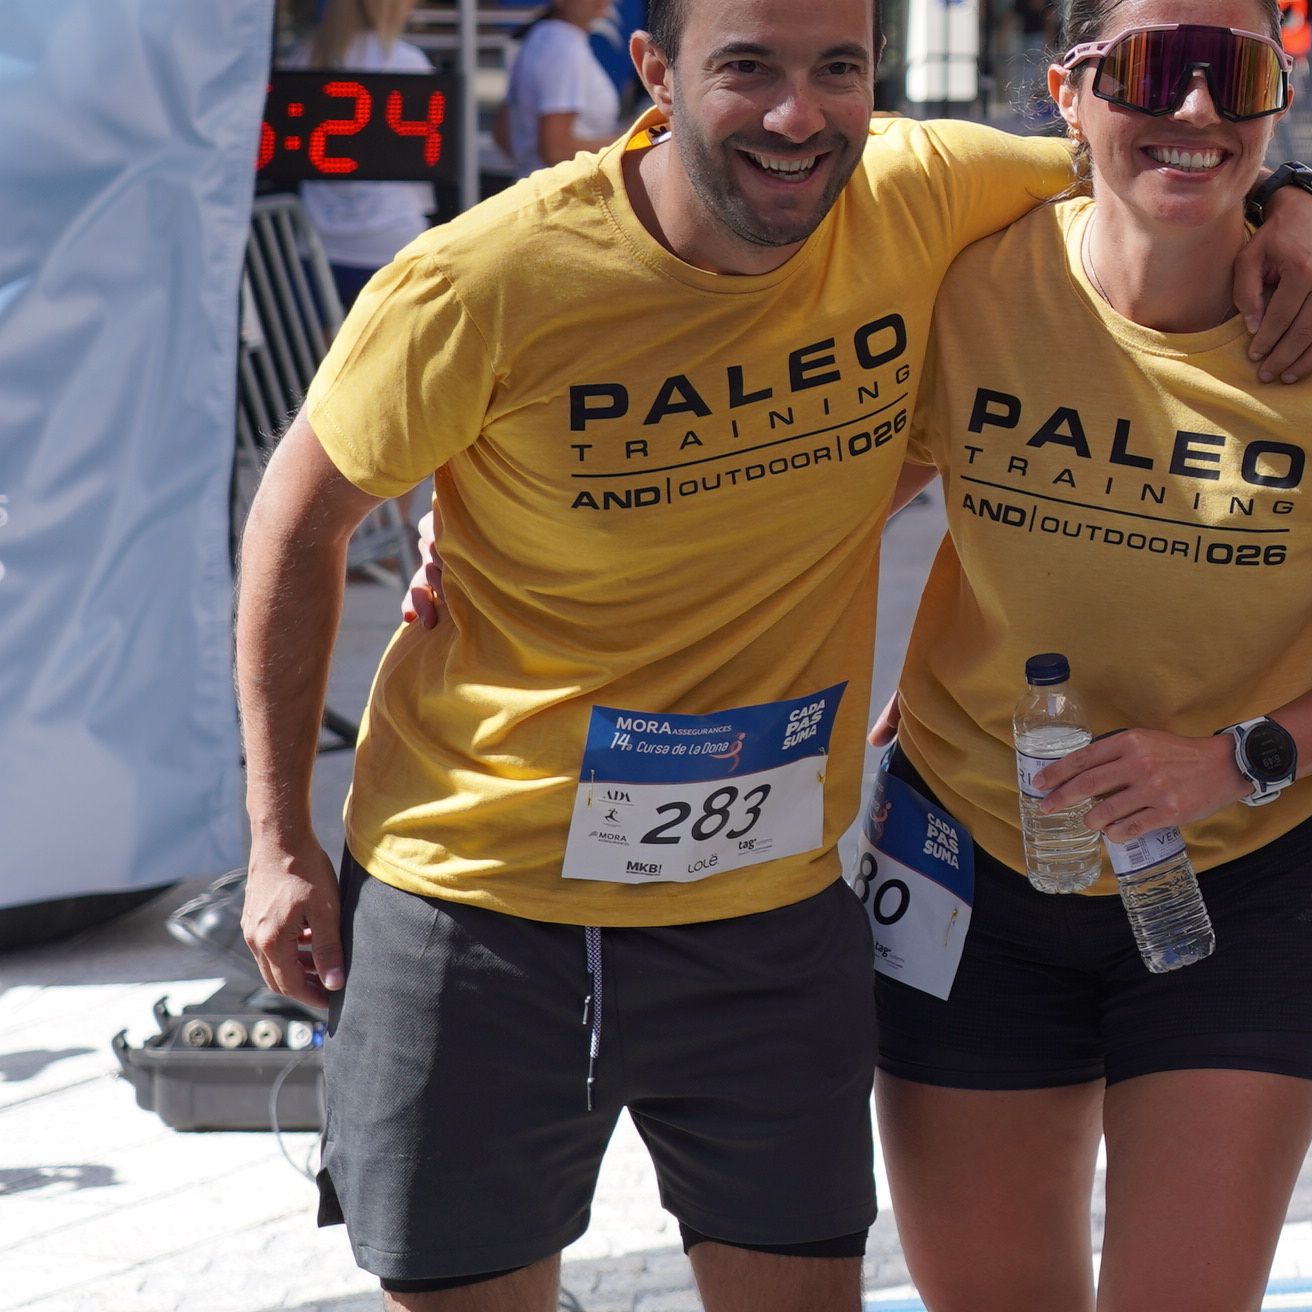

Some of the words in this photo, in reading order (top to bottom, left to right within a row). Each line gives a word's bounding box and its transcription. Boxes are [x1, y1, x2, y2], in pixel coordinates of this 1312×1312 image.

[569, 313, 908, 432] PALEO
[571, 364, 910, 462] TRAINING
[967, 388, 1306, 489] PALEO
[964, 445, 1295, 516] TRAINING
[785, 710, 823, 737] PAS
[789, 699, 826, 722] CADA
[616, 716, 672, 735] MORA
[672, 724, 732, 736] ASSEGURANCES
[781, 725, 817, 751] SUMA
[636, 741, 669, 755] Cursa
[671, 744, 686, 755] de
[688, 745, 701, 755] la
[701, 742, 730, 755] Dona
[640, 784, 772, 845] 283
[927, 812, 958, 842] CADA
[598, 832, 627, 842] MORA
[927, 823, 960, 855] PAS
[626, 860, 662, 874] MKB!
[922, 839, 960, 870] SUMA
